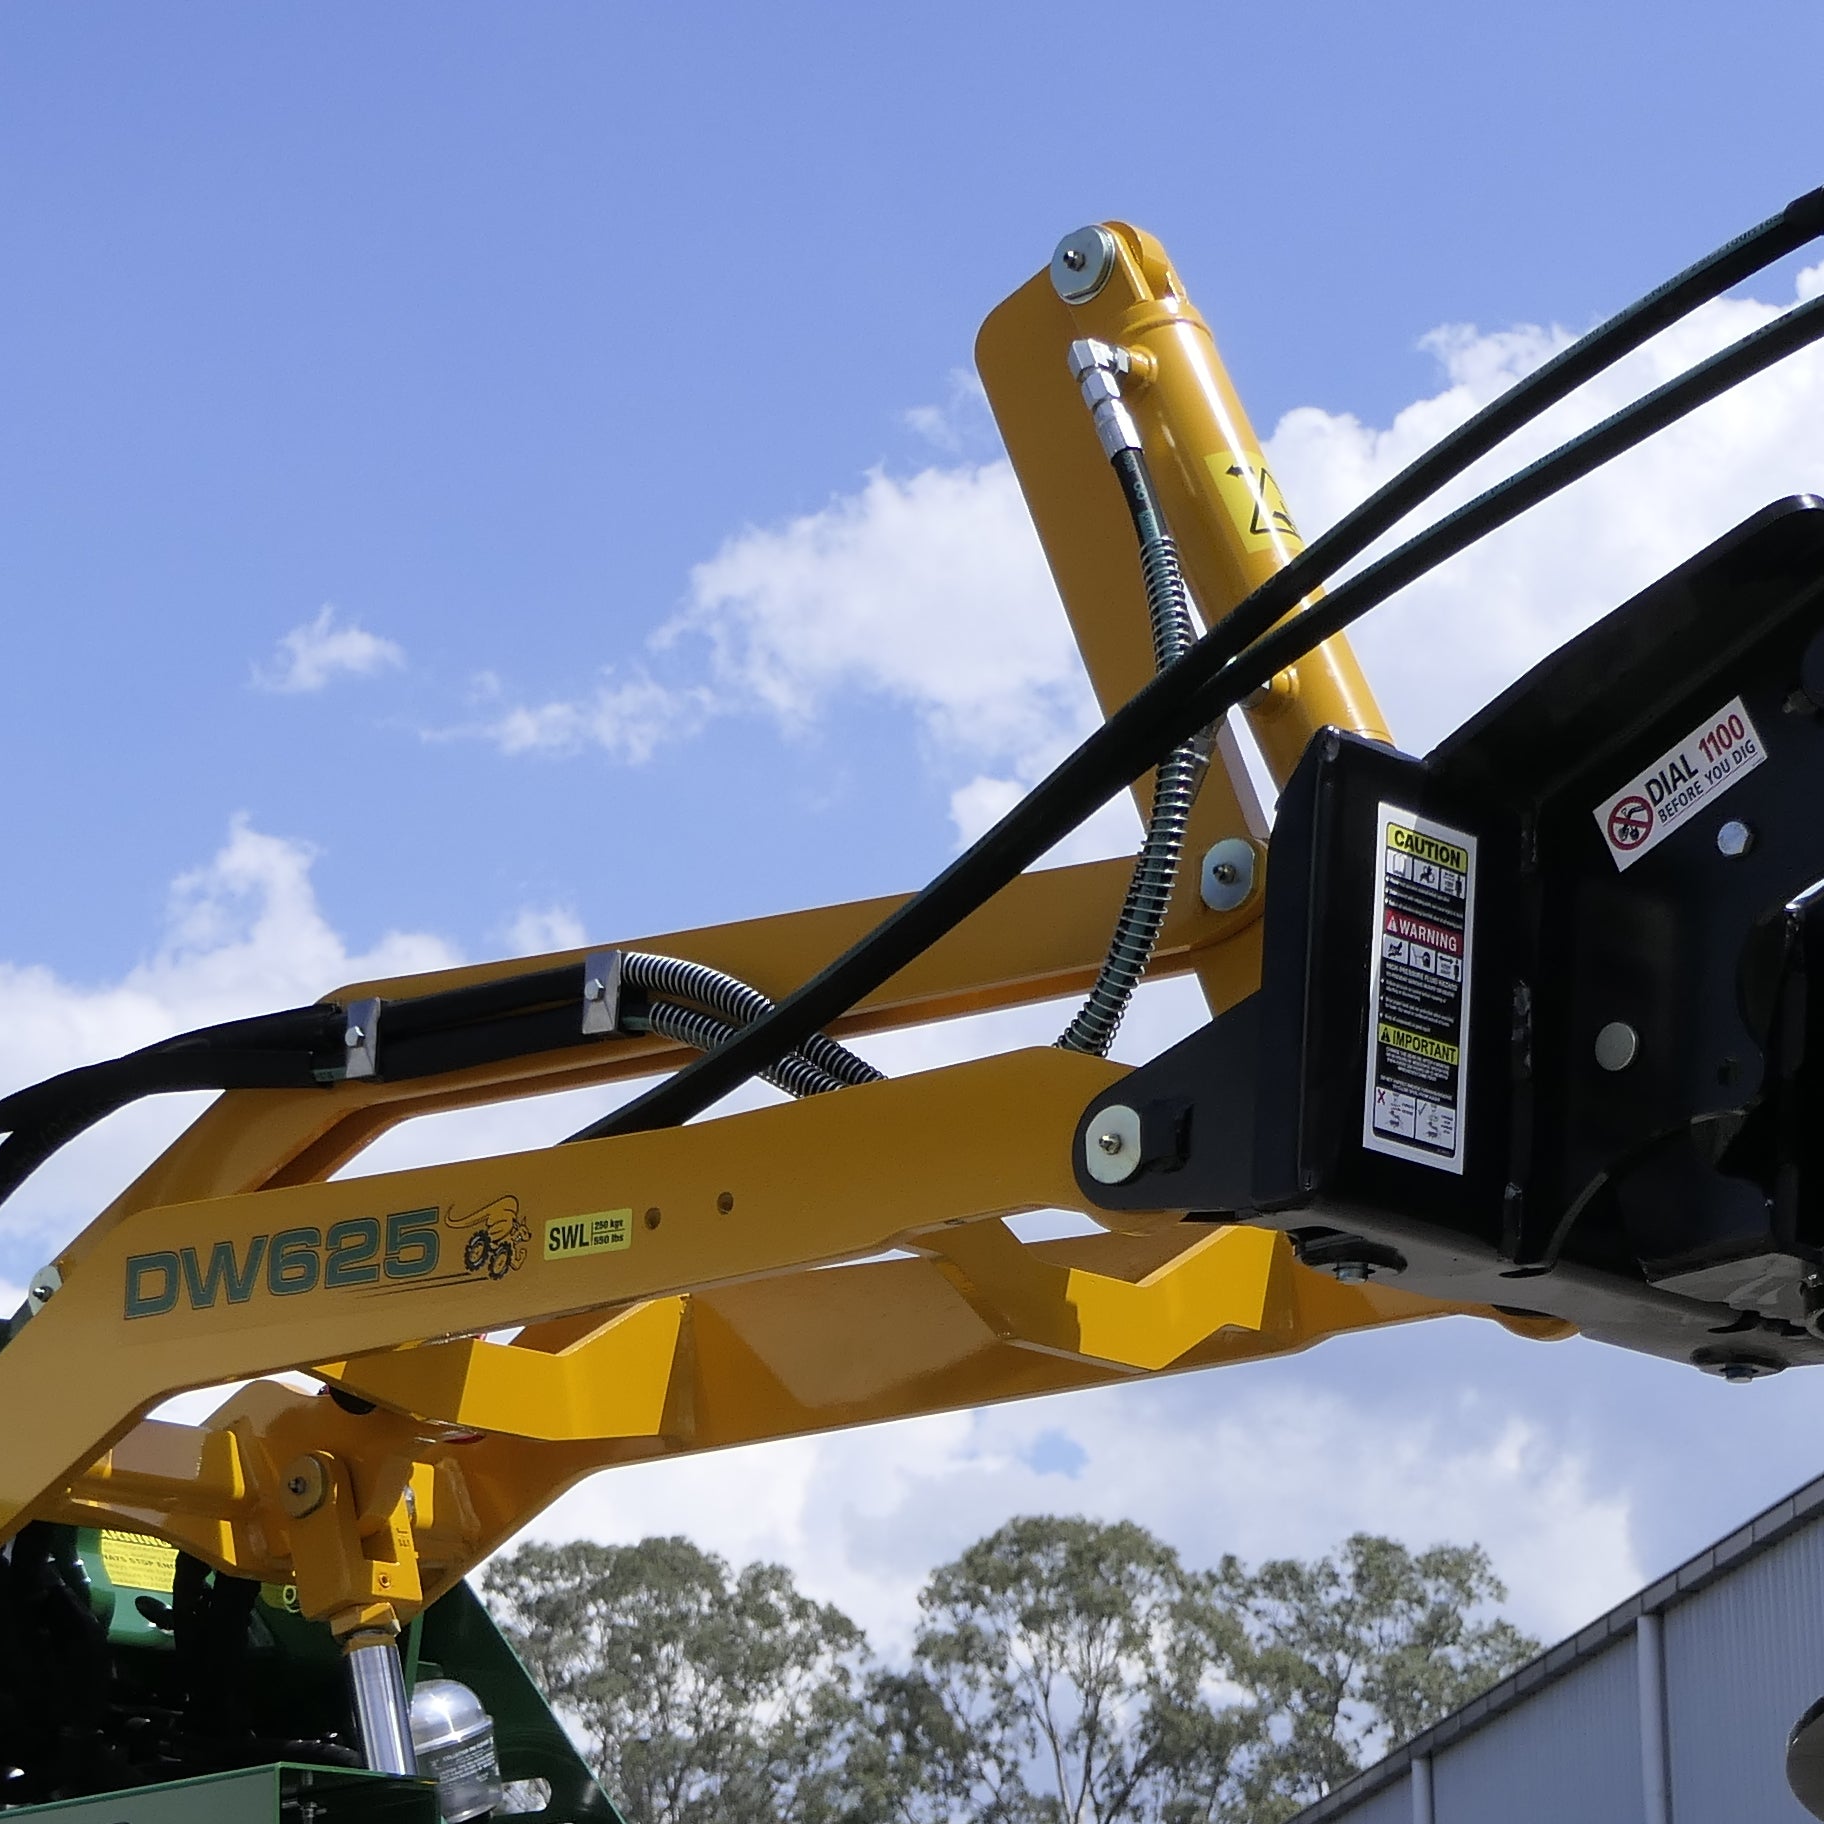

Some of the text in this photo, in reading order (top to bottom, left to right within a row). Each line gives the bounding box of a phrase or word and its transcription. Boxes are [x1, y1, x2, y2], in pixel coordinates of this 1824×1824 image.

[1644, 714, 1745, 807] DIAL 1100
[1657, 739, 1756, 824] BEFORE YOU DIG
[1394, 829, 1460, 868] CAUTION
[1399, 918, 1457, 952] WARNING
[1392, 1030, 1456, 1062] IMPORTANT
[549, 1223, 589, 1251] SWL
[123, 1206, 440, 1320] DW625
